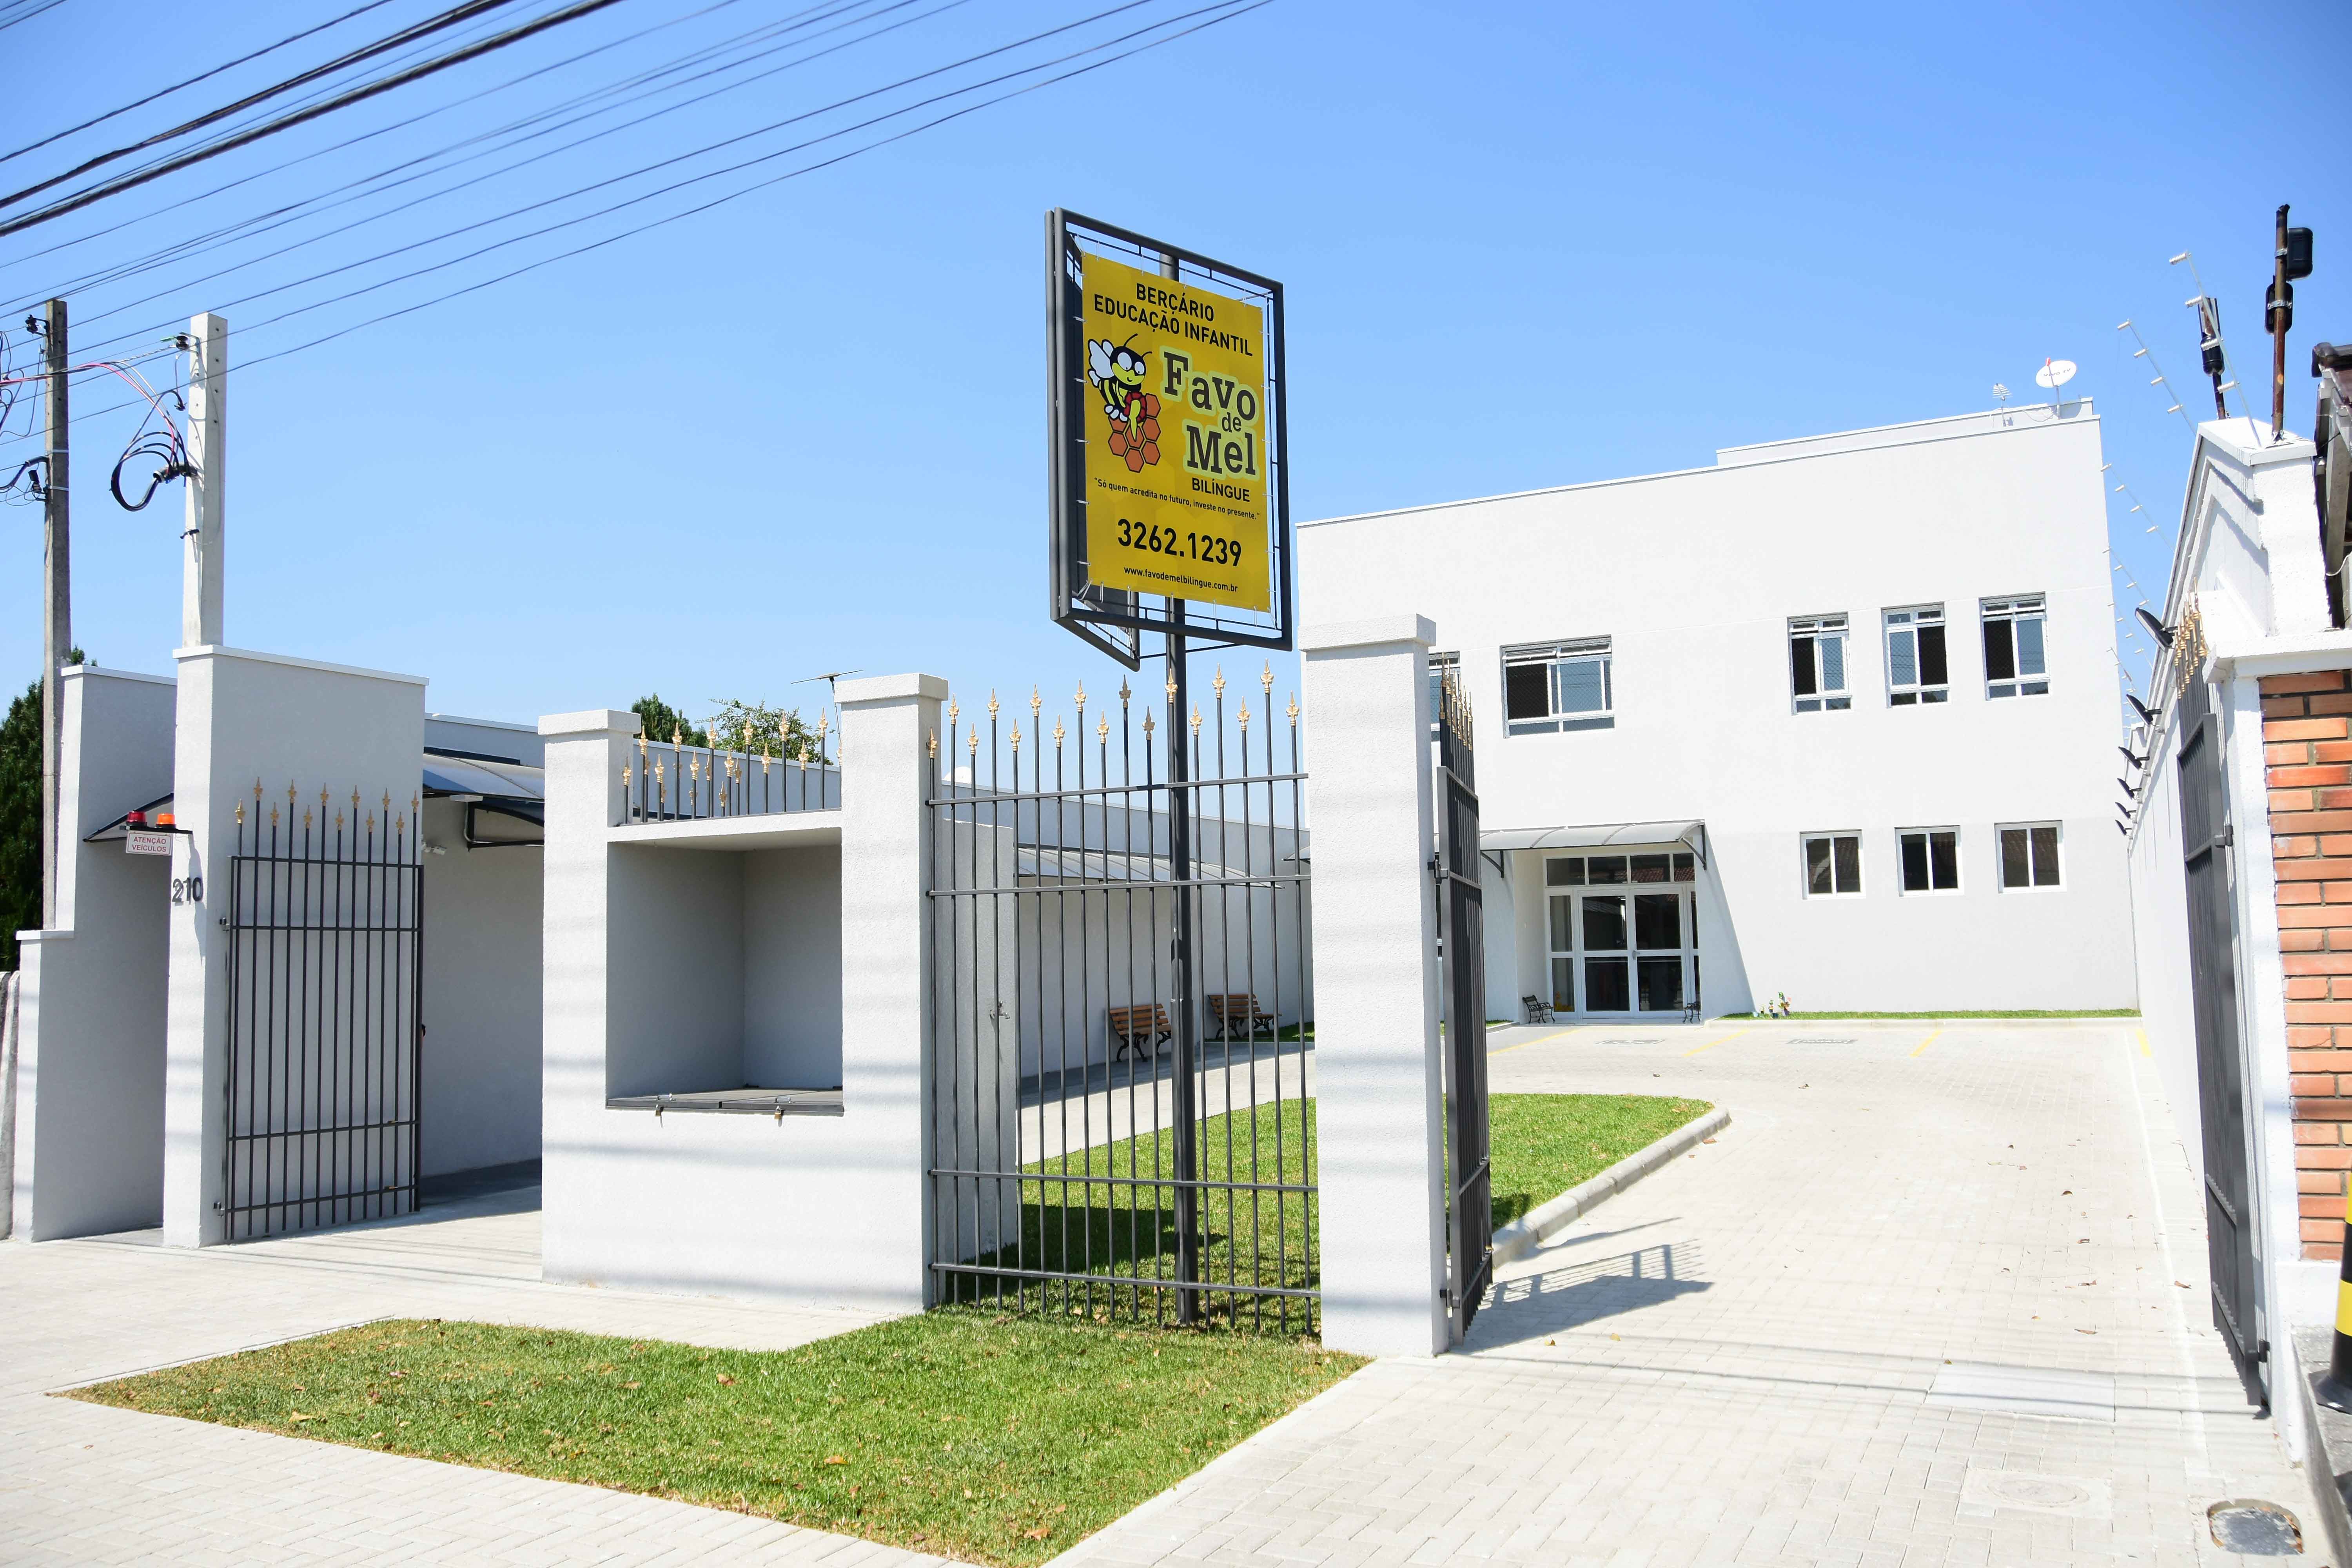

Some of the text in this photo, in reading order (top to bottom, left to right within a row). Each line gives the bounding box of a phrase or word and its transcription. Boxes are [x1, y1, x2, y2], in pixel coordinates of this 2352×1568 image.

[1136, 283, 1214, 322] BERÇÁRIO
[1094, 294, 1253, 357] EDUCAÇÃO INFANTIL
[1163, 351, 1256, 421] Favo
[1221, 412, 1242, 433] de
[1186, 425, 1256, 476] Mel
[1109, 483, 1129, 493] quem
[1130, 488, 1158, 499] acredita
[1169, 494, 1192, 507] futuro,
[1193, 499, 1216, 511] investe
[1192, 477, 1250, 502] BILÍNGUE
[1117, 518, 1242, 567] 3262.1239
[1123, 567, 1238, 593] www.favodemelbilingue.com.br
[132, 844, 167, 852] VEÍCULOS
[133, 837, 166, 845] ATENÇÃO
[172, 877, 204, 903] 210
